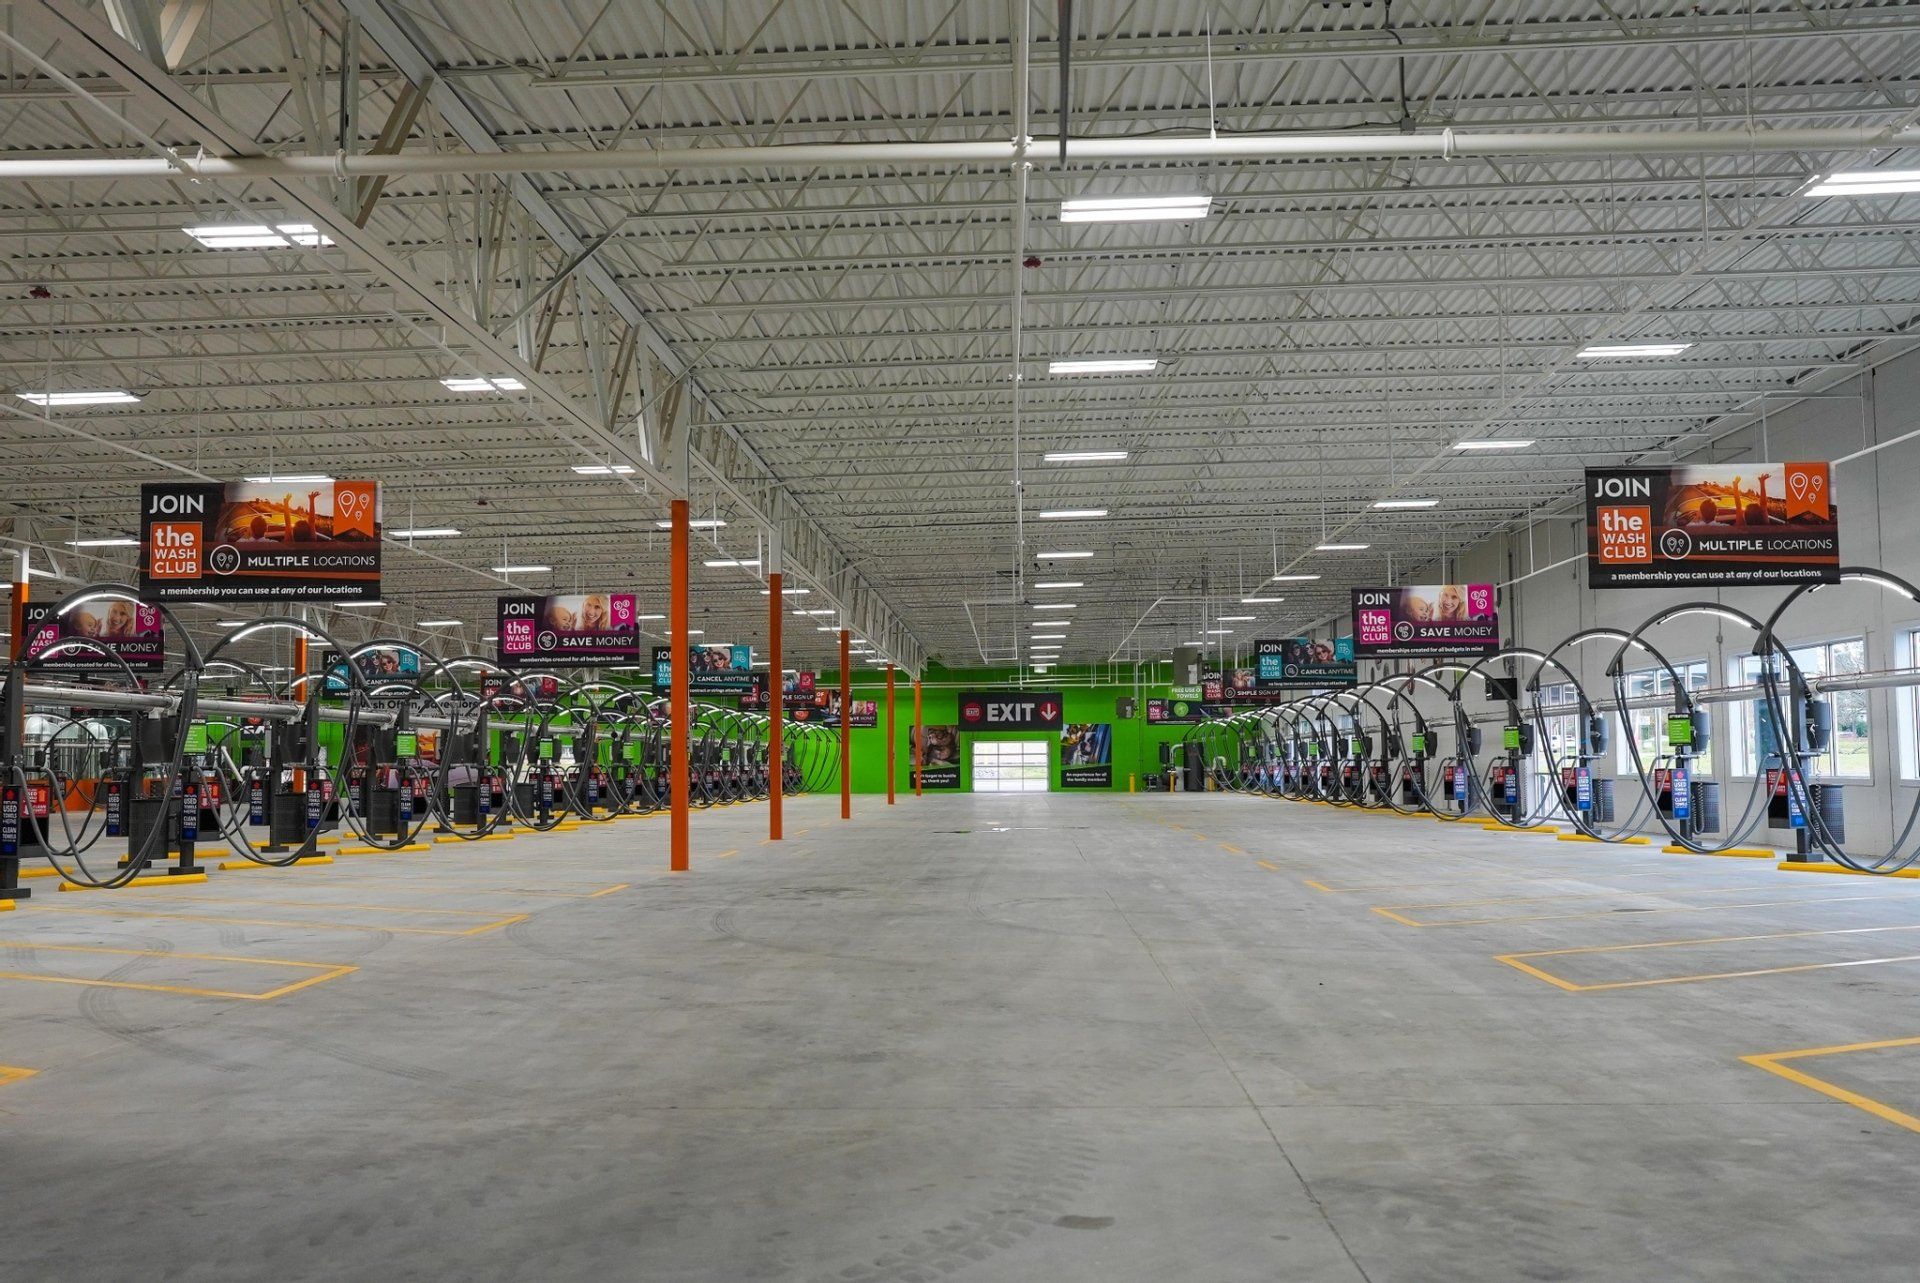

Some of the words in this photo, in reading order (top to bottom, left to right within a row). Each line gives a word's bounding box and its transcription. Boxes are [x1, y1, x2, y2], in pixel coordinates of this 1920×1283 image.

[1595, 478, 1650, 498] JOIN
[150, 494, 204, 514] JOIN
[1602, 510, 1643, 531] the
[156, 526, 194, 547] the
[1603, 533, 1645, 544] WASH
[1700, 540, 1763, 550] MULTIPLE
[1768, 539, 1832, 550] LOCATIONS
[155, 549, 197, 559] WASH
[1603, 546, 1647, 558] CLUB
[248, 556, 309, 567] MULTIPLE
[313, 556, 375, 566] LOCATIONS
[155, 562, 197, 573] CLUB
[1618, 572, 1673, 581] membership
[1674, 572, 1690, 581] you
[1736, 572, 1751, 580] any
[1753, 570, 1763, 578] of
[1781, 569, 1821, 577] locations
[167, 586, 220, 596] membership
[221, 588, 237, 596] you
[238, 587, 253, 595] can
[255, 587, 270, 595] use
[281, 587, 296, 595] any
[297, 586, 307, 594] of
[323, 586, 362, 594] locations
[1358, 593, 1390, 605] JOIN
[503, 603, 535, 615] JOIN
[1362, 612, 1386, 625] the
[507, 622, 530, 634] the
[1420, 628, 1450, 637] SAVE
[1454, 627, 1492, 636] MONEY
[506, 642, 531, 650] CLUB
[563, 637, 592, 646] SAVE
[596, 637, 633, 646] MONEY
[121, 643, 158, 652] MONEY
[1259, 644, 1282, 653] JOIN
[1262, 657, 1279, 665] the
[987, 703, 1035, 721] EXIT
[3, 805, 17, 813] USED
